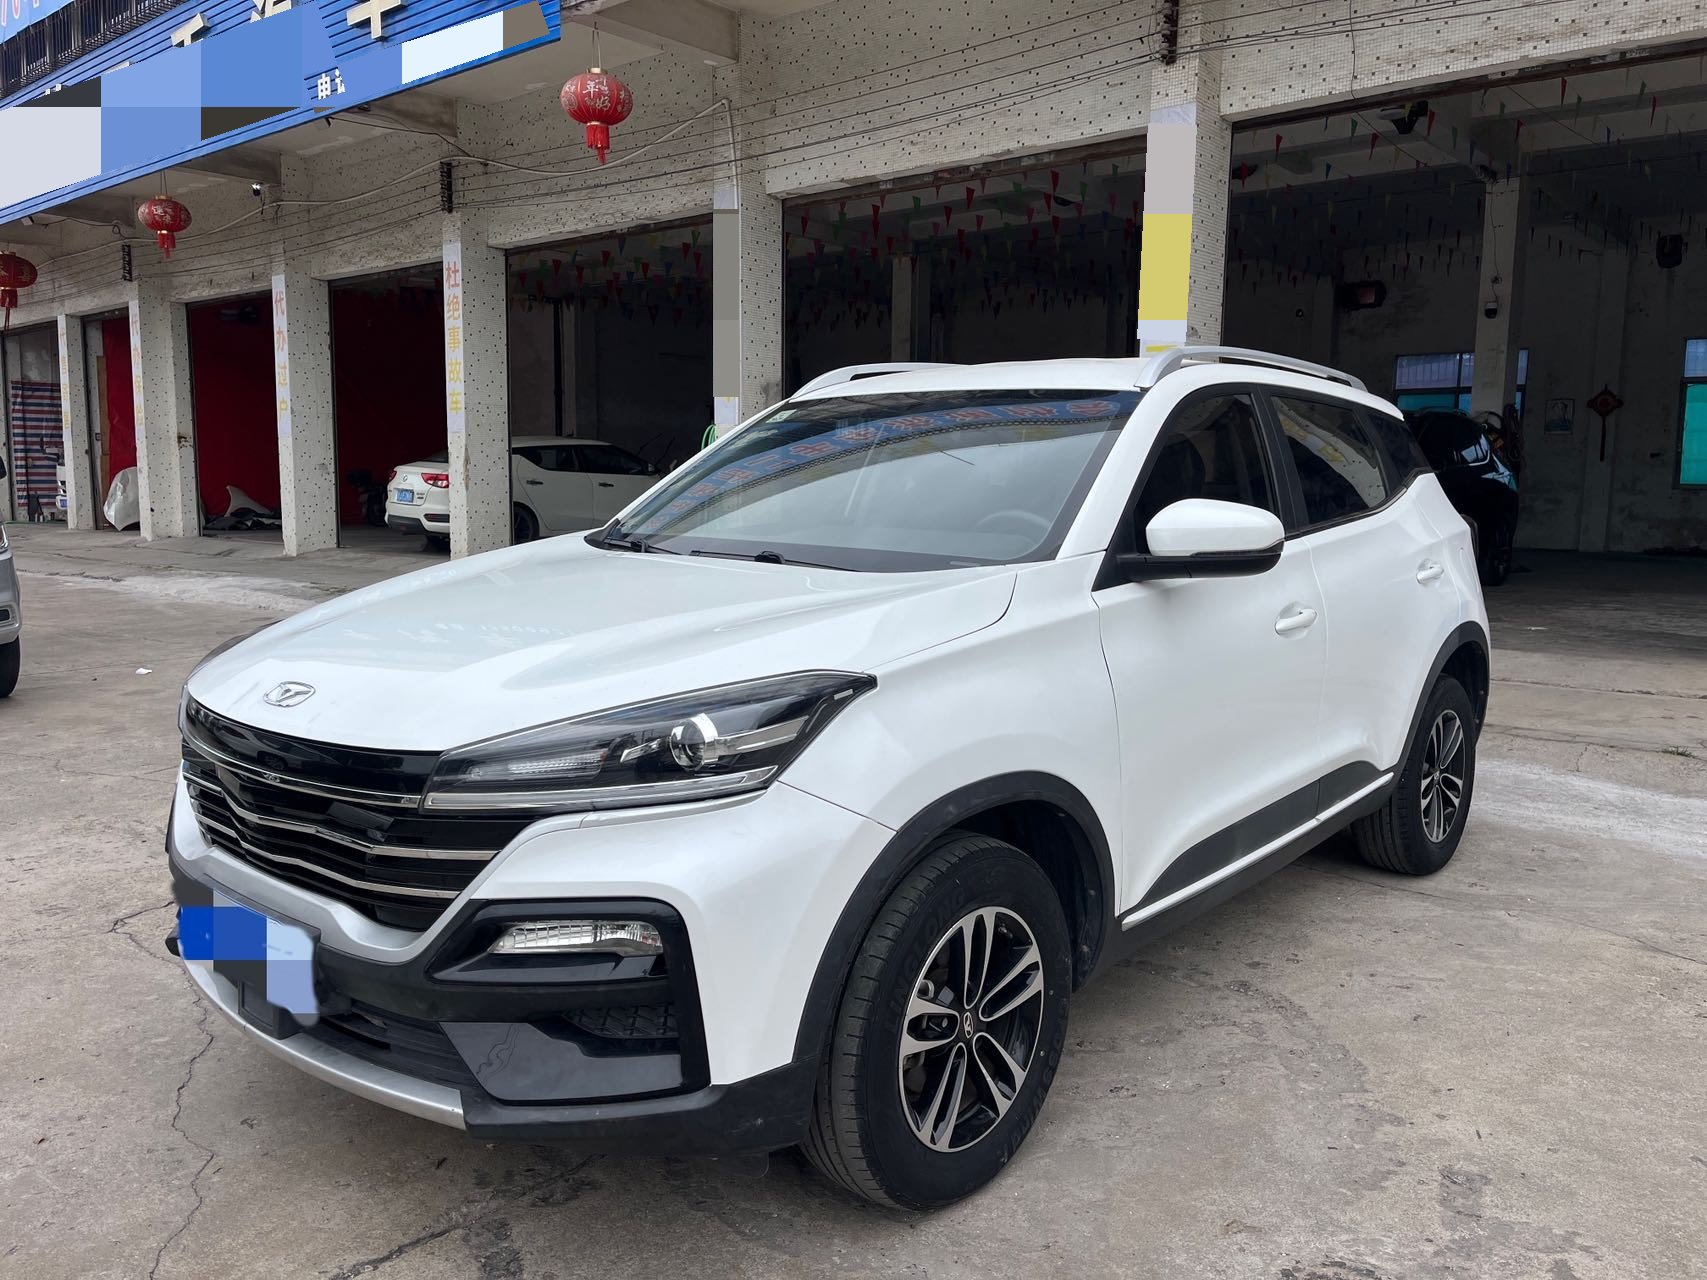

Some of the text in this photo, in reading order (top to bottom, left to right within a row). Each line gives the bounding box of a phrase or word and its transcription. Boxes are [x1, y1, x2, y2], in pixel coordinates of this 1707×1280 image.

[445, 261, 463, 414] 杜绝事故车
